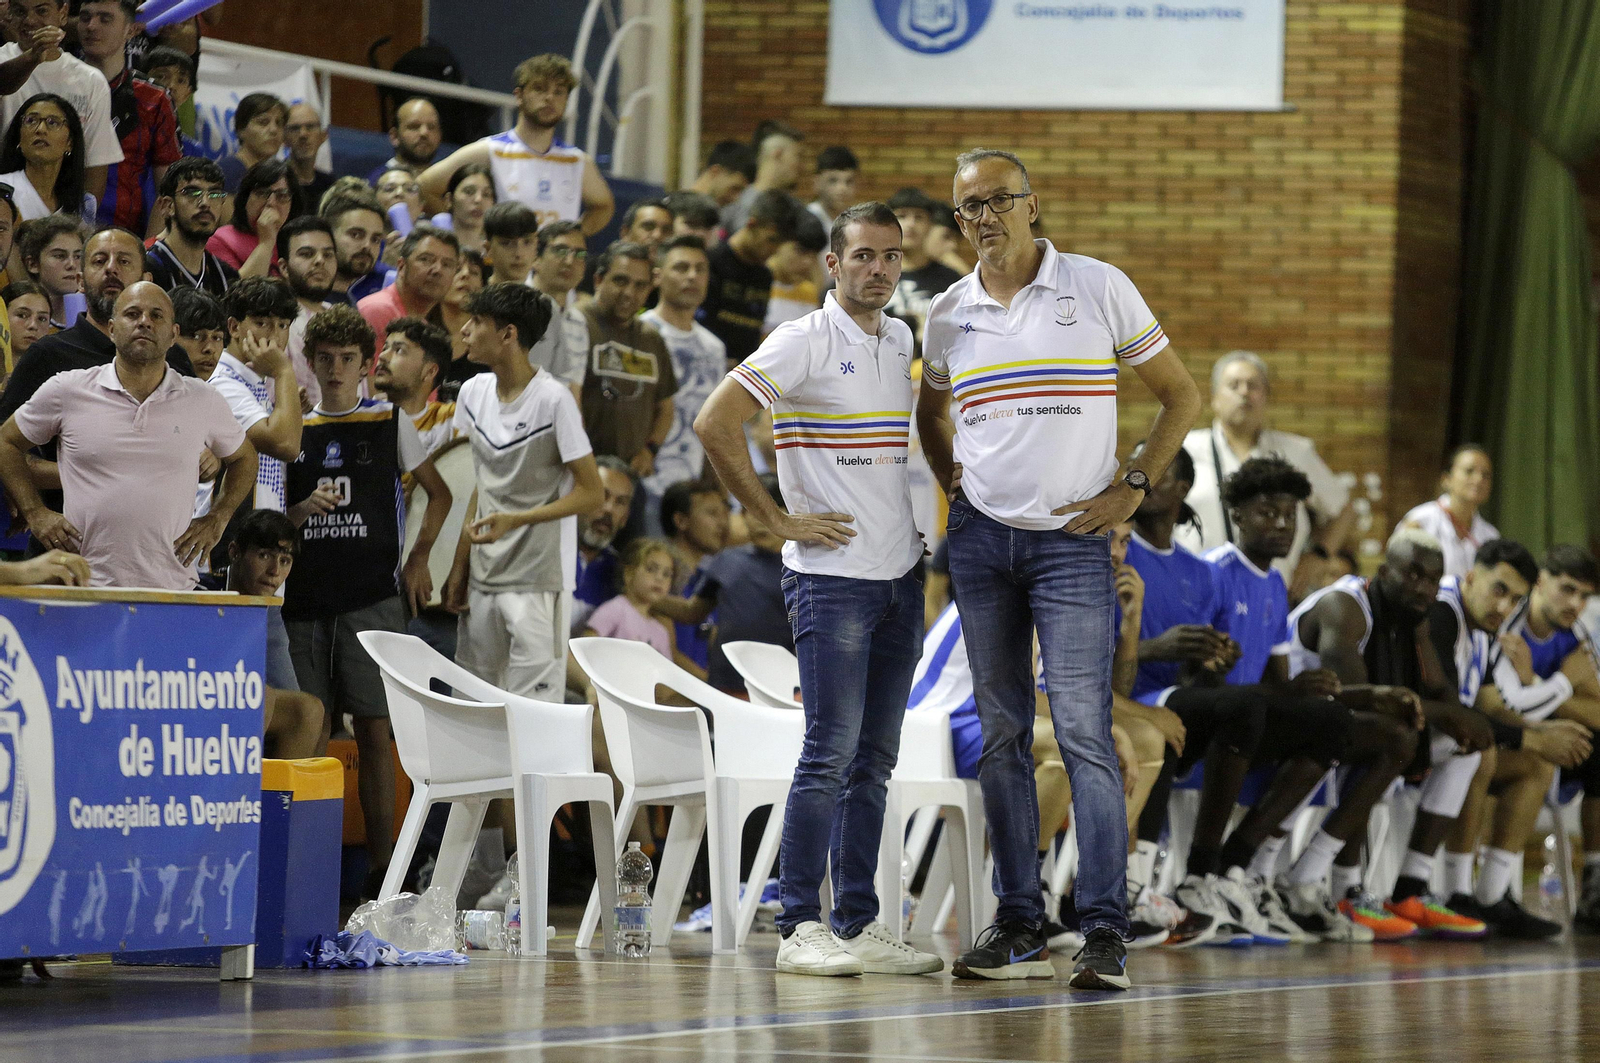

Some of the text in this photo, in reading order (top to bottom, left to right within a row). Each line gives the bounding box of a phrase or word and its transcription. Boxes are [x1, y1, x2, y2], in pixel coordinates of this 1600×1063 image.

[964, 413, 987, 427] Huelva
[988, 408, 1013, 420] eleva
[1017, 407, 1034, 415] tus
[836, 455, 872, 465] Huelva
[308, 513, 363, 527] HUELVA
[303, 525, 368, 540] DEPORTE
[56, 655, 263, 724] Ayuntamiento
[119, 723, 262, 777] de Huelva
[69, 795, 262, 836] Concejalía de Deportes
